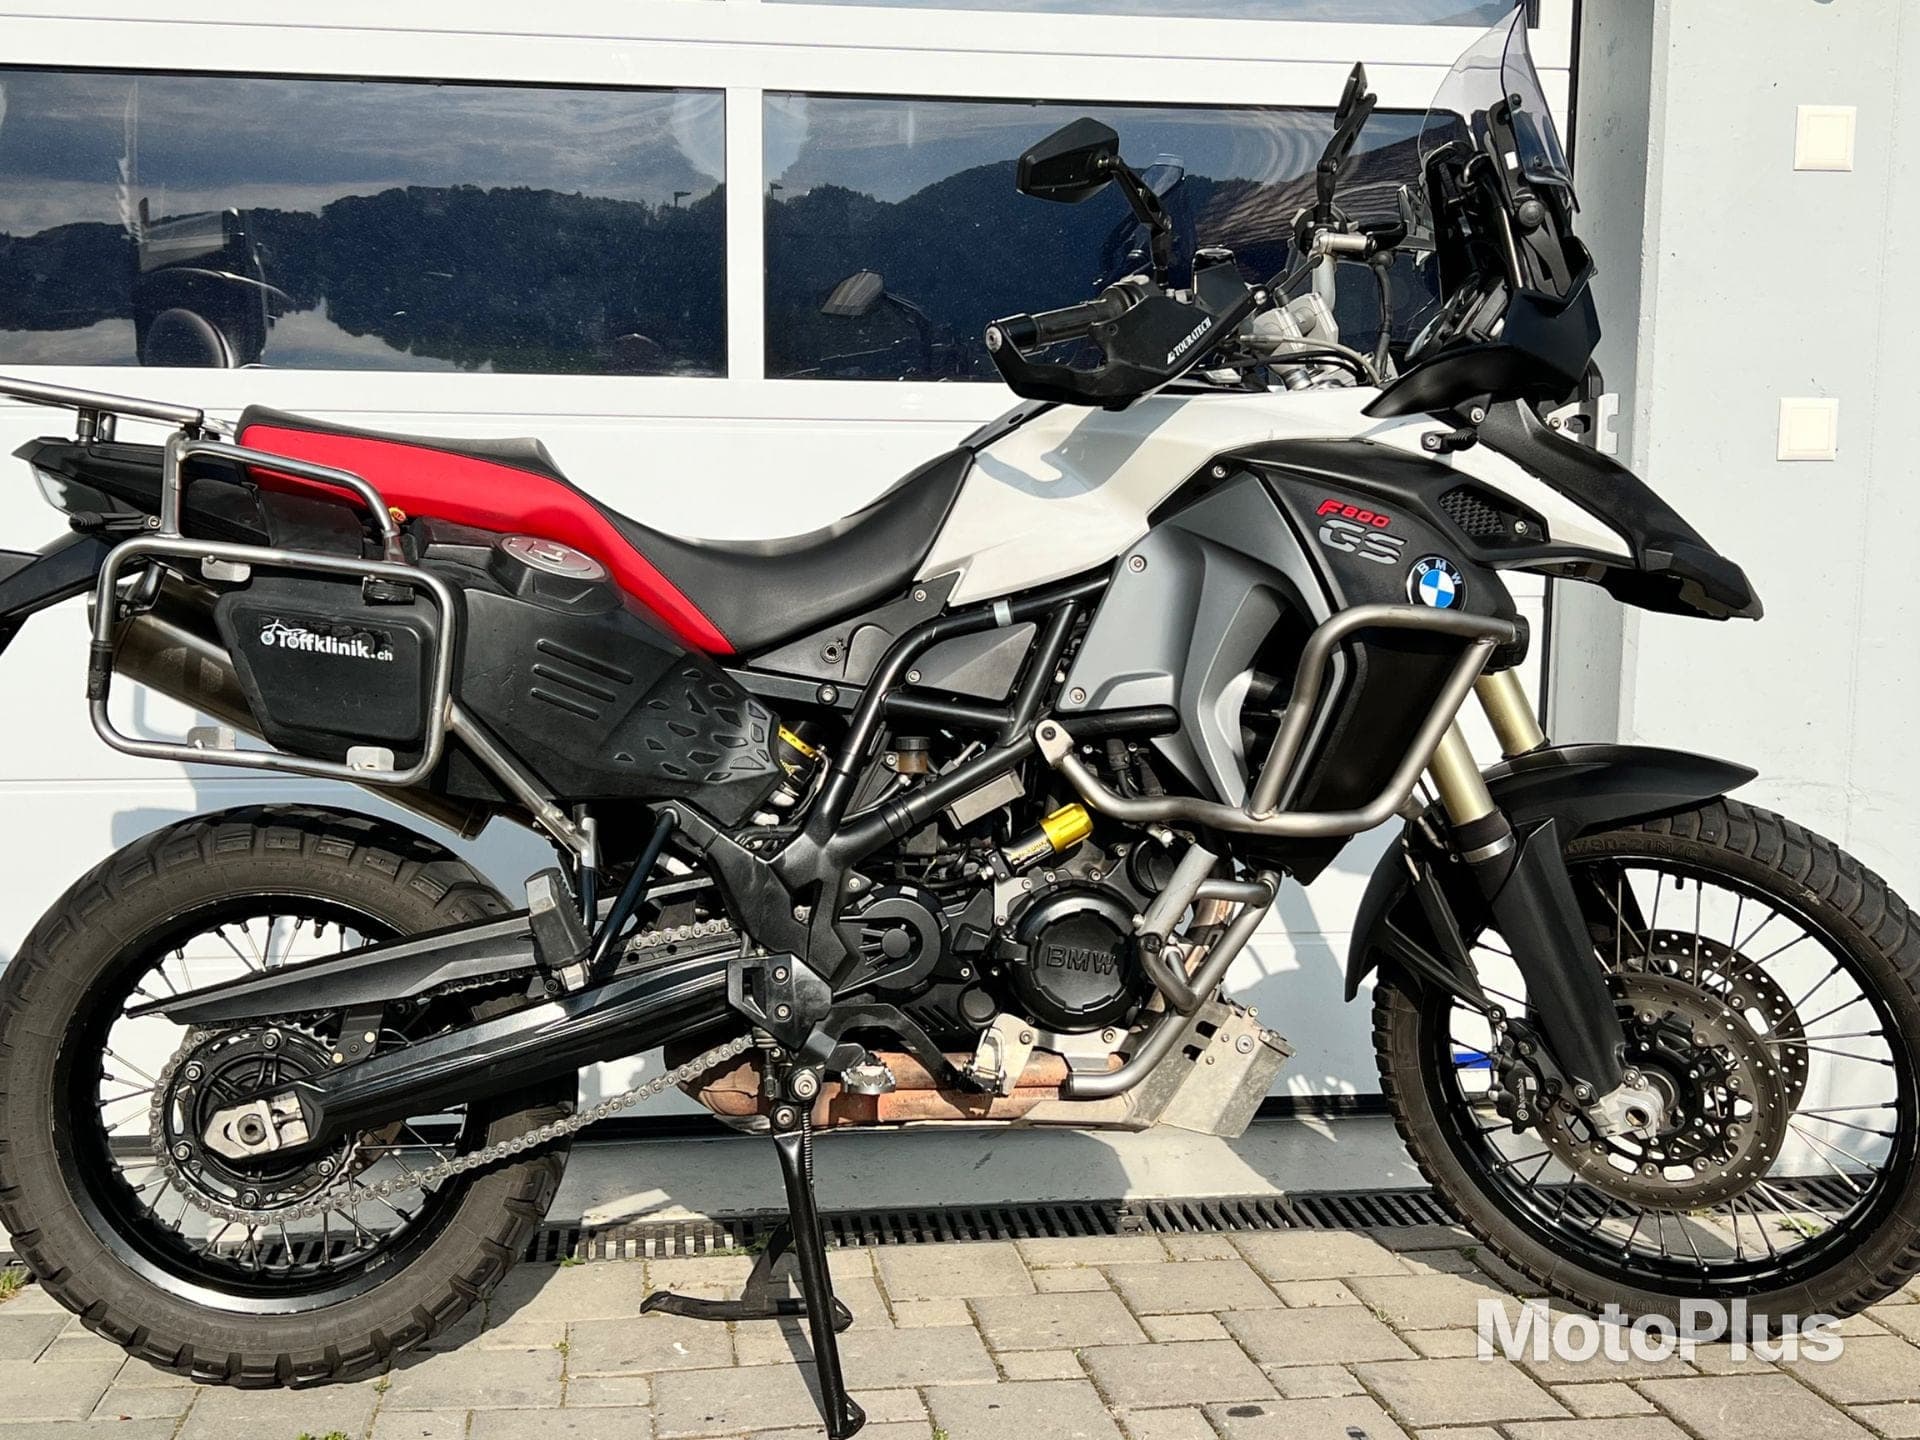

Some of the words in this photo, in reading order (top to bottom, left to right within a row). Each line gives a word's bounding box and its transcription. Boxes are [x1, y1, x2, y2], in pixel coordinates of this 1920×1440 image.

[1173, 316, 1212, 356] TOURATECH
[1317, 499, 1390, 528] F800
[1319, 519, 1407, 565] GS
[1417, 558, 1463, 585] BMW
[1046, 944, 1117, 975] BMW
